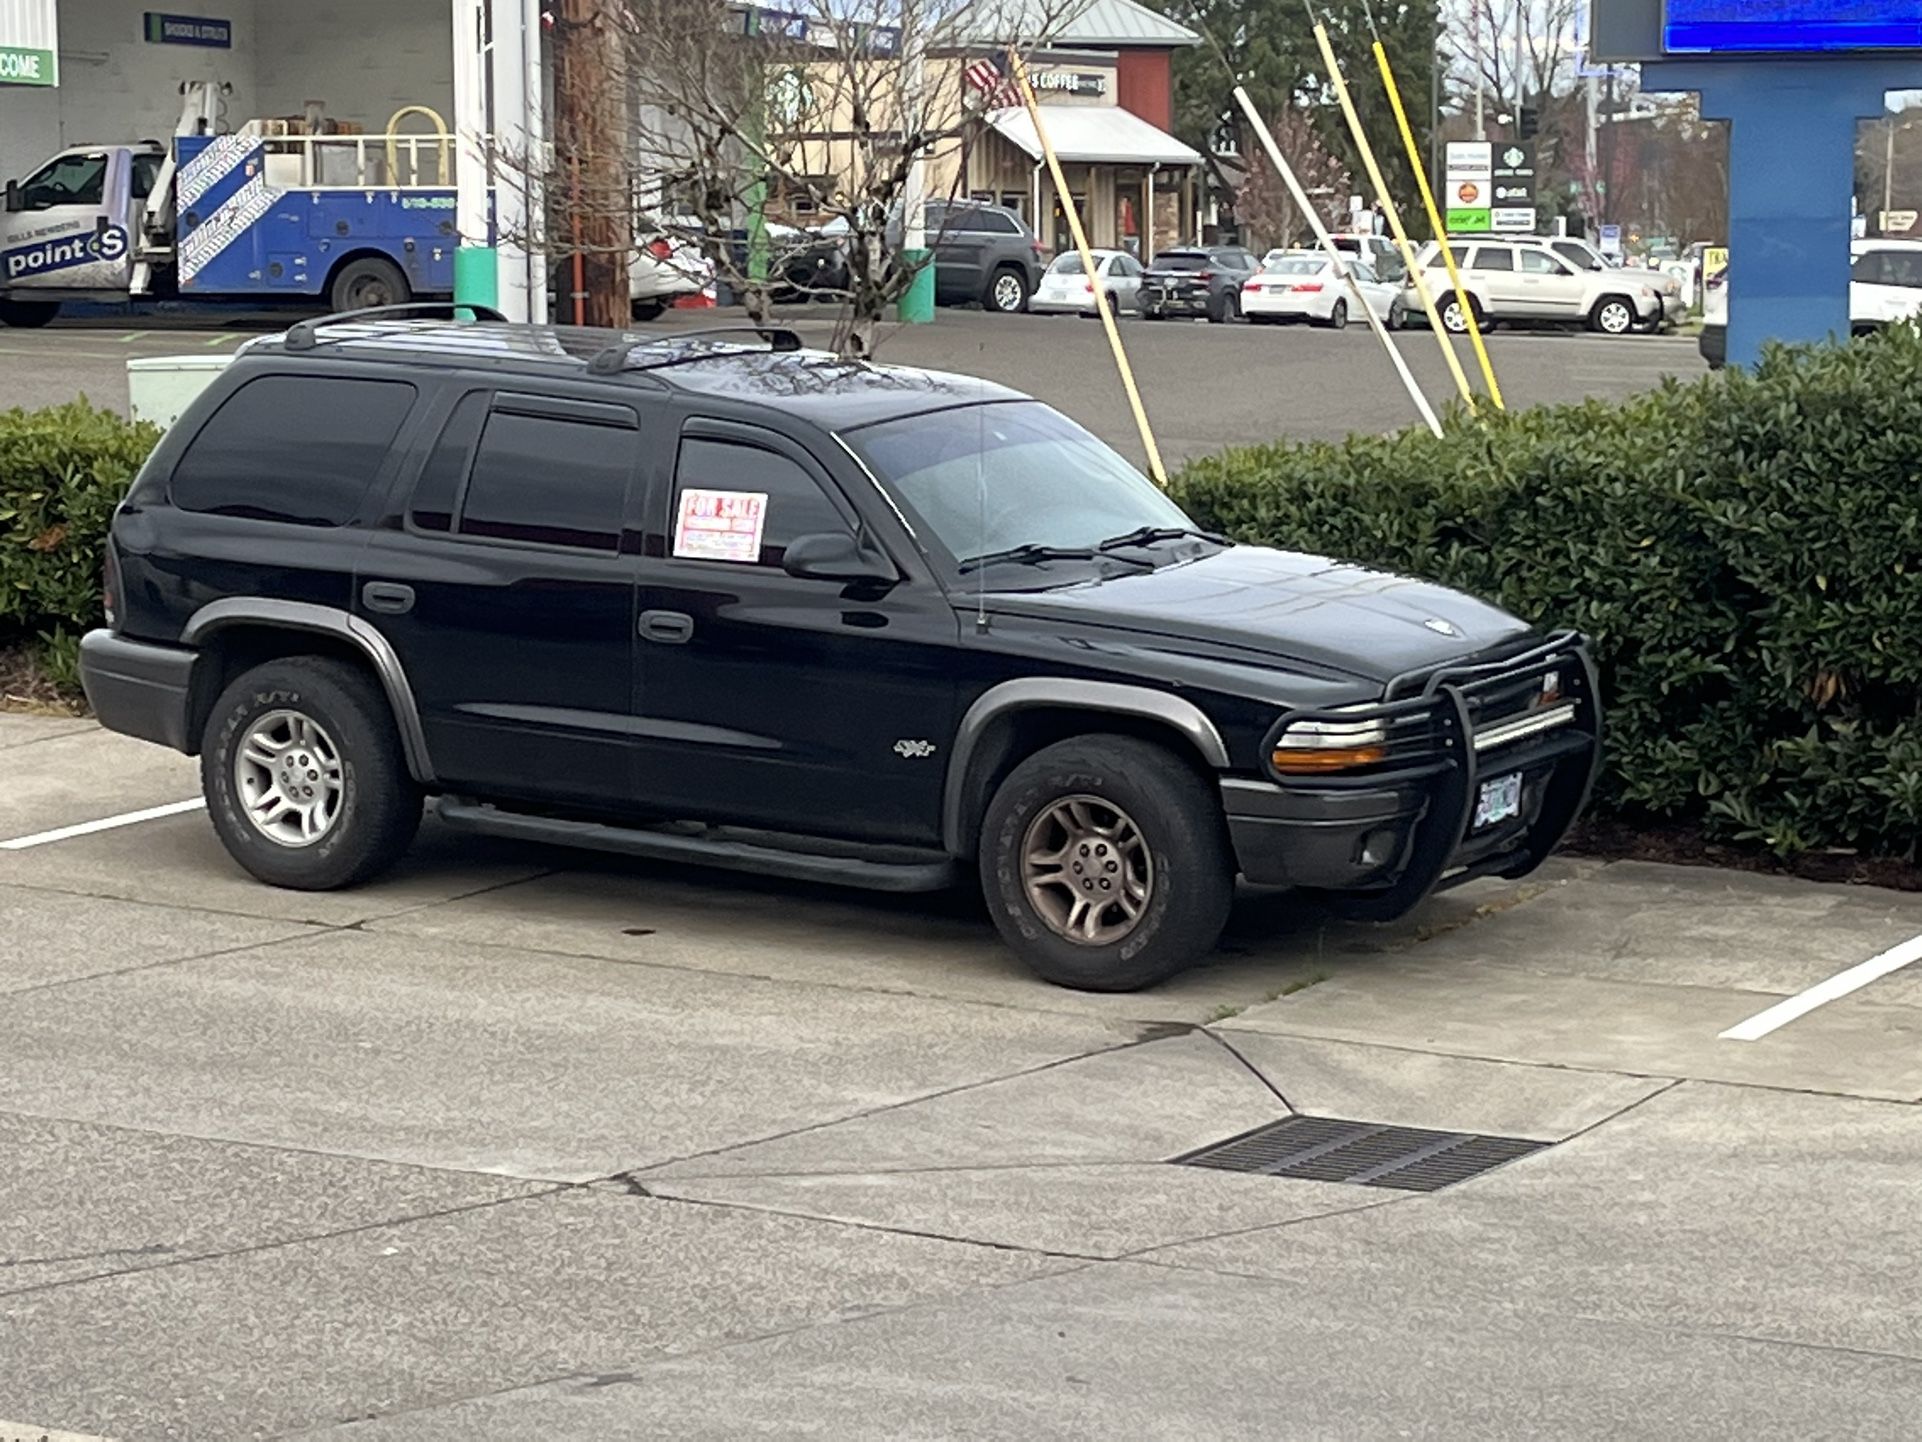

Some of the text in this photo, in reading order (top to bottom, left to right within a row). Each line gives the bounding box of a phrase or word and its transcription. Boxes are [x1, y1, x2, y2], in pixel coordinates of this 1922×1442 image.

[1040, 72, 1079, 90] COFFEE
[8, 229, 123, 277] point S
[685, 494, 760, 519] FOR SALE
